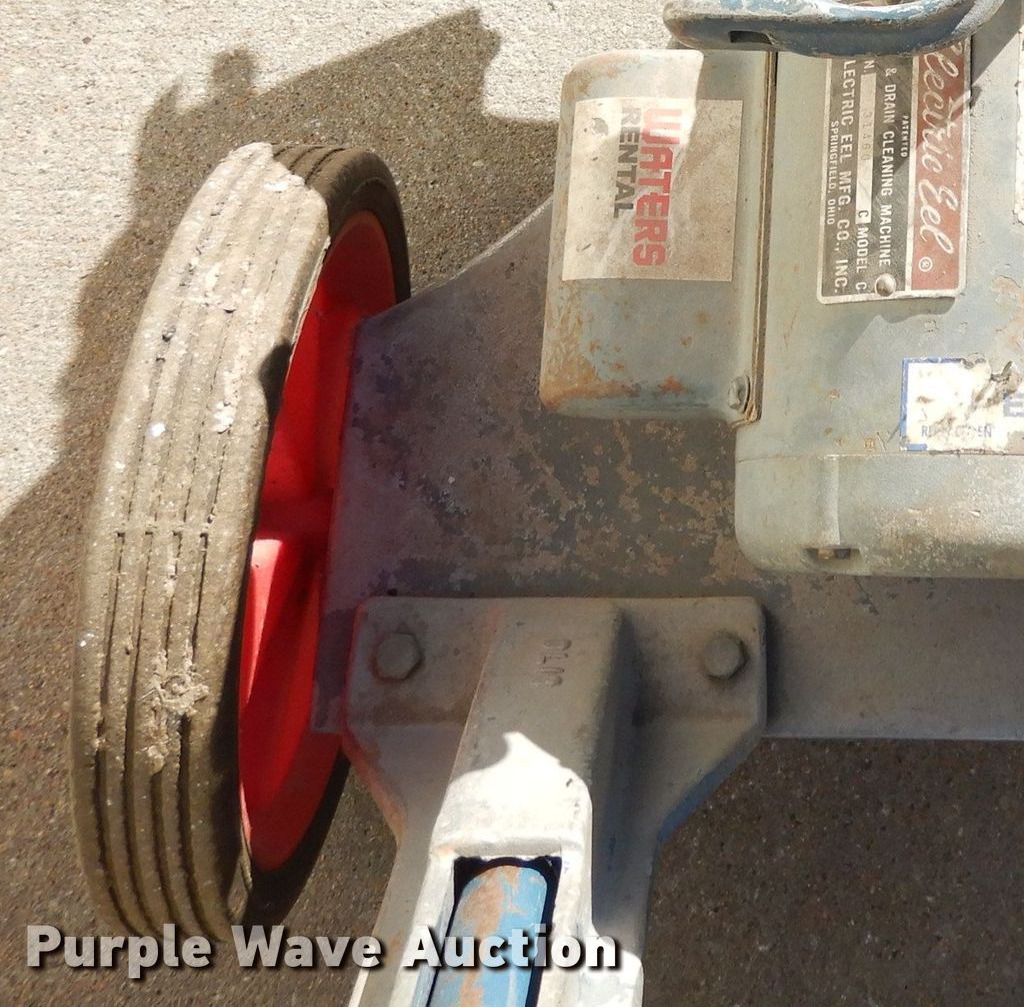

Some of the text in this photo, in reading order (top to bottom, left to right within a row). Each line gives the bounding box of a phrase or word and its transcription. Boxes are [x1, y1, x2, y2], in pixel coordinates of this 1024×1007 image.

[838, 133, 853, 164] EEL
[900, 115, 909, 158] PATENTED
[613, 106, 641, 219] RENTAL
[879, 68, 897, 267] & DRAIN CLEANING MACHINE
[632, 108, 682, 266] WATERS
[836, 170, 852, 212] MFG.
[826, 199, 836, 225] OHIO
[918, 179, 960, 254] Eel
[855, 226, 869, 274] MODEL
[833, 258, 849, 294] INC.
